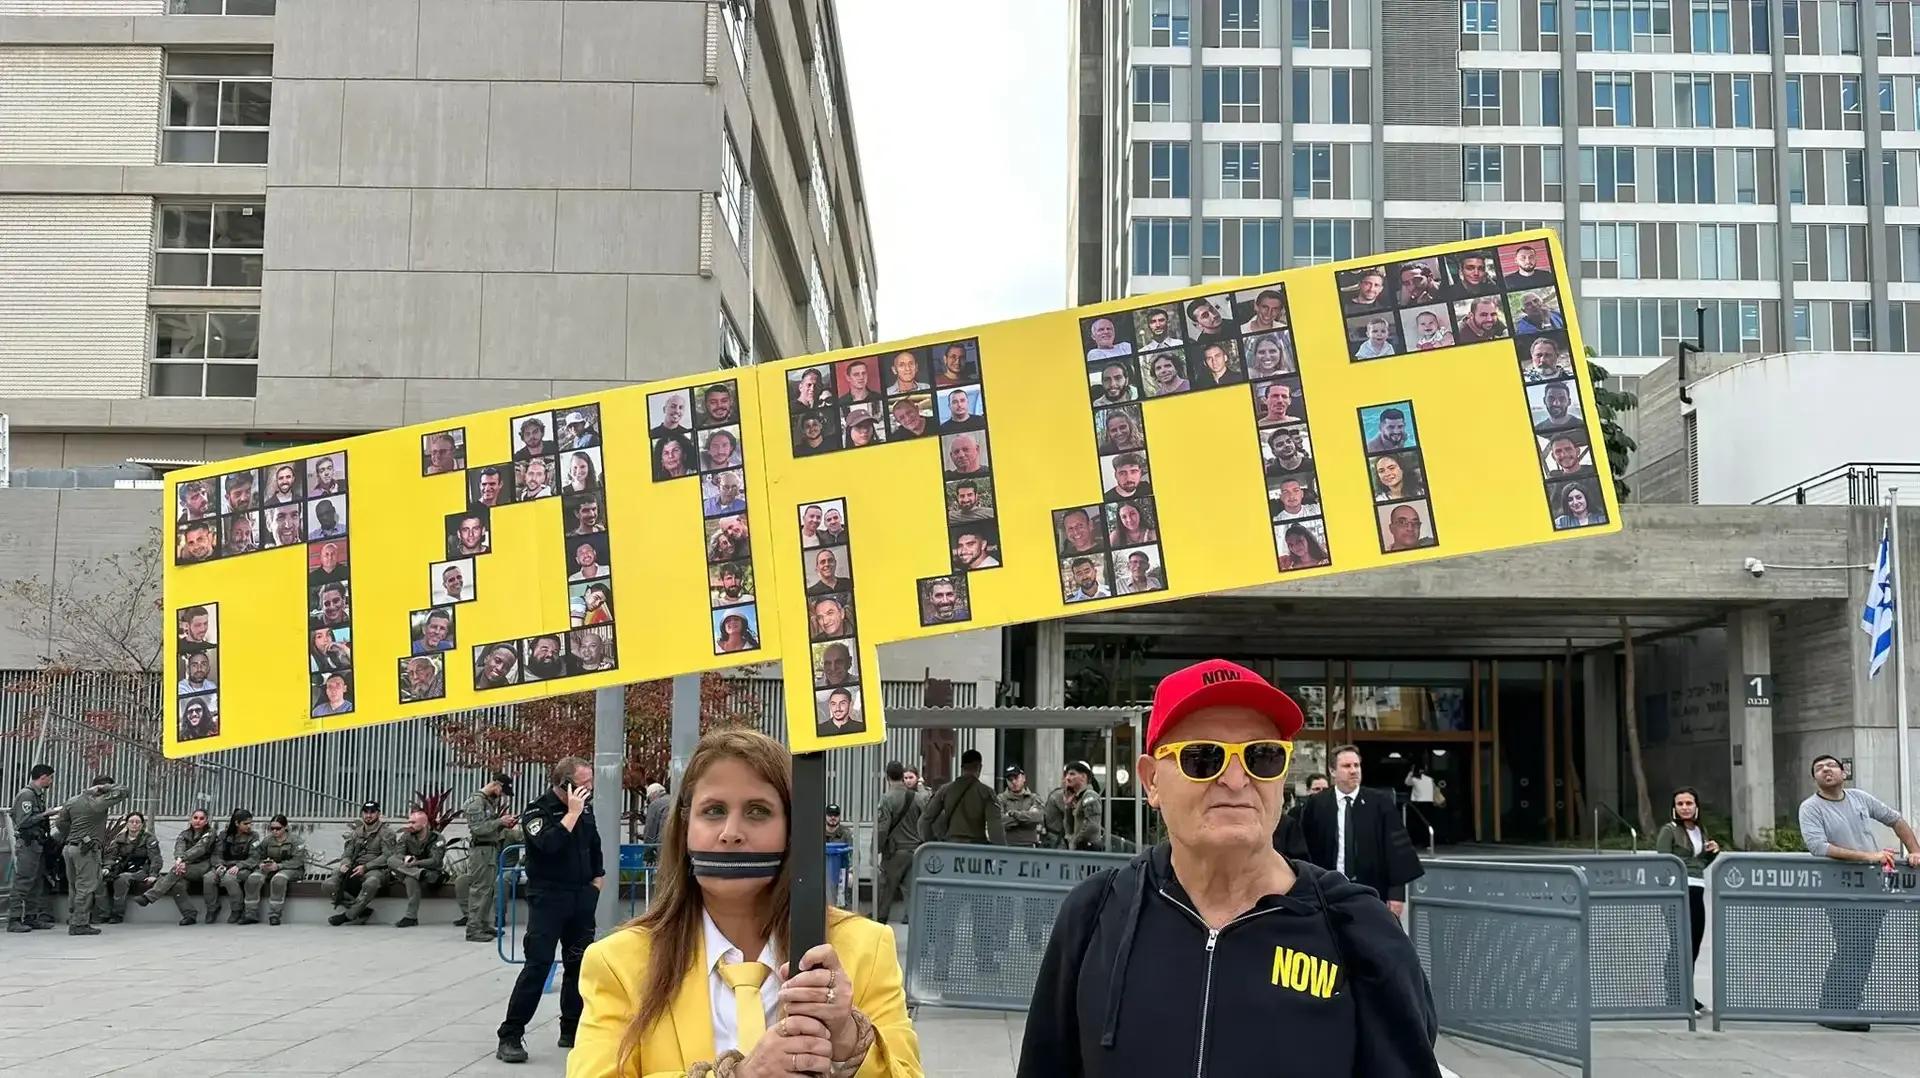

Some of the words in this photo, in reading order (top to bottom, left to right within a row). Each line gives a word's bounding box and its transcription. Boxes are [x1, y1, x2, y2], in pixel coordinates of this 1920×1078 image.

[1202, 669, 1241, 686] NOW
[1749, 676, 1763, 697] 1
[1747, 697, 1770, 706] מבנה
[1751, 868, 1823, 888] המשפט
